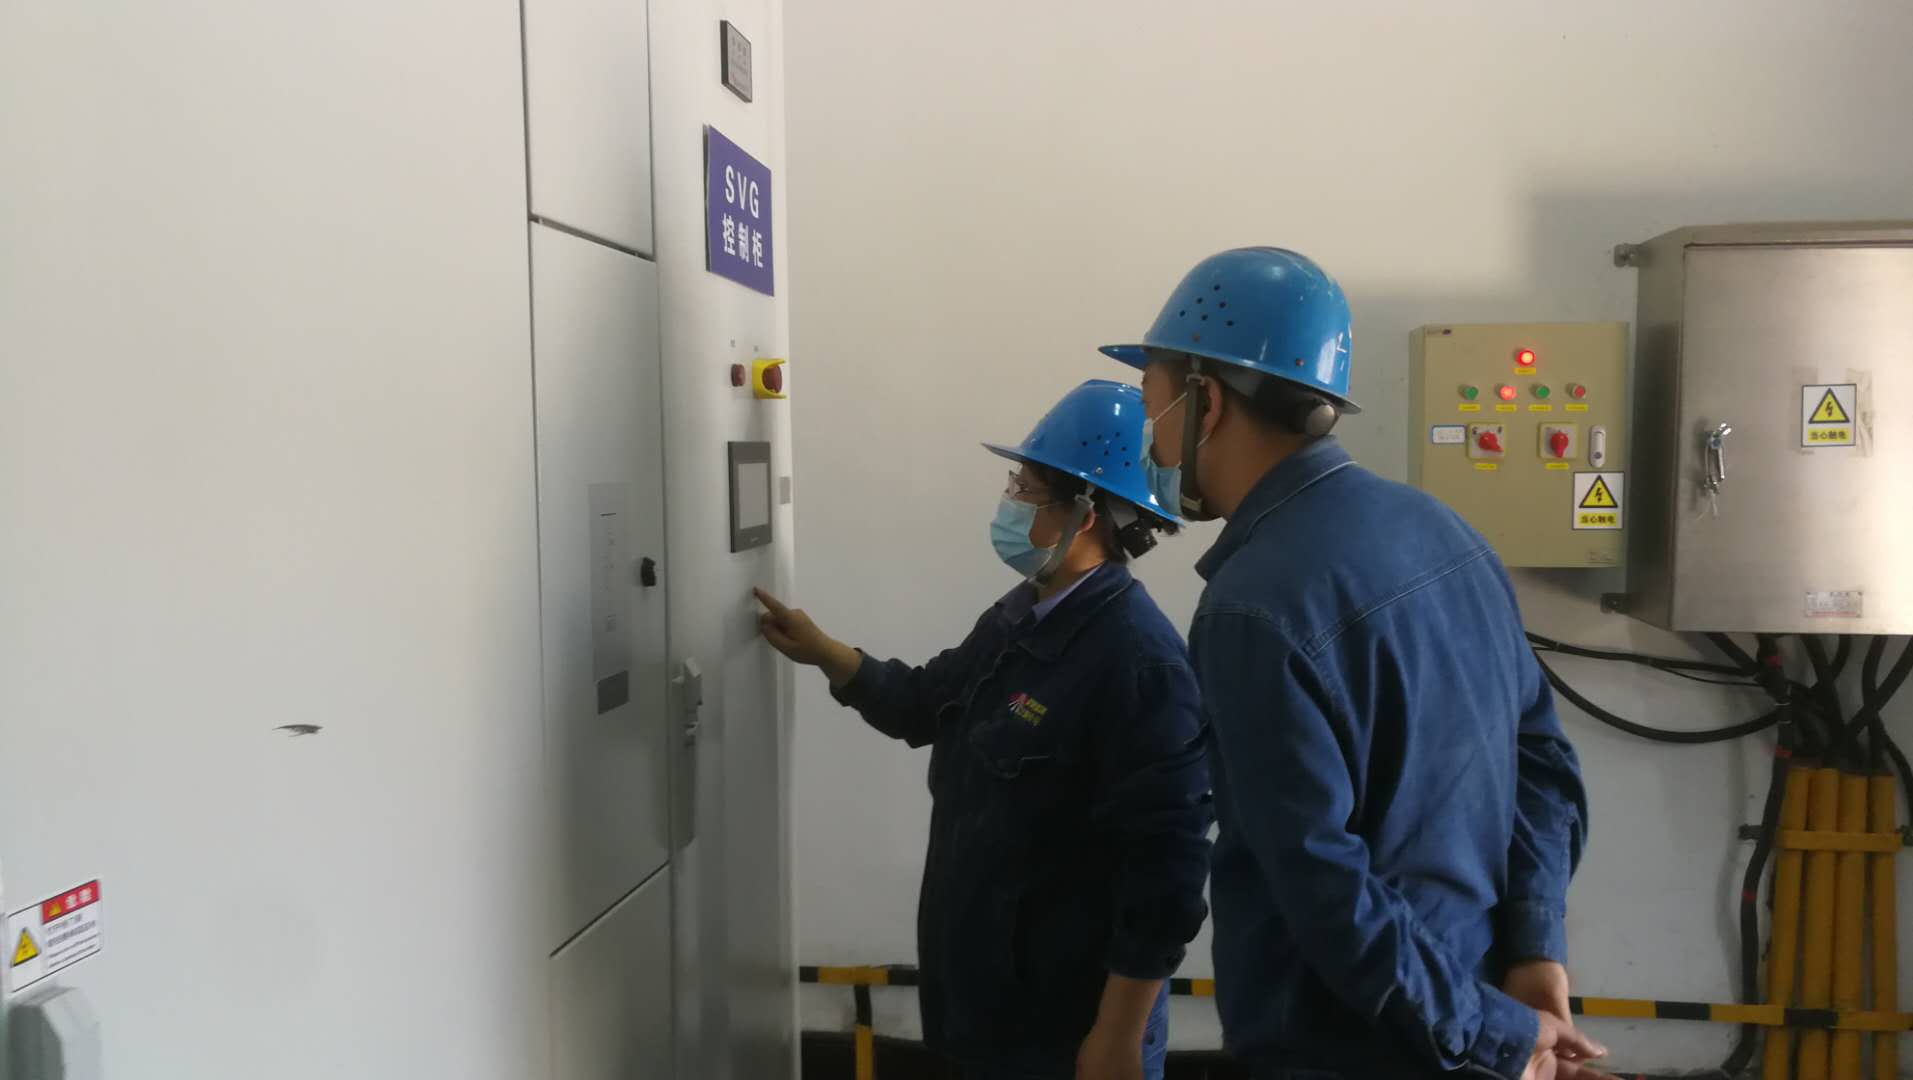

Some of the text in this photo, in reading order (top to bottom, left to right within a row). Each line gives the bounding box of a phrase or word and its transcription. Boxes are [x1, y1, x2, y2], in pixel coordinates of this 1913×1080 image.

[725, 165, 760, 218] SVG
[723, 213, 763, 268] 控制柜
